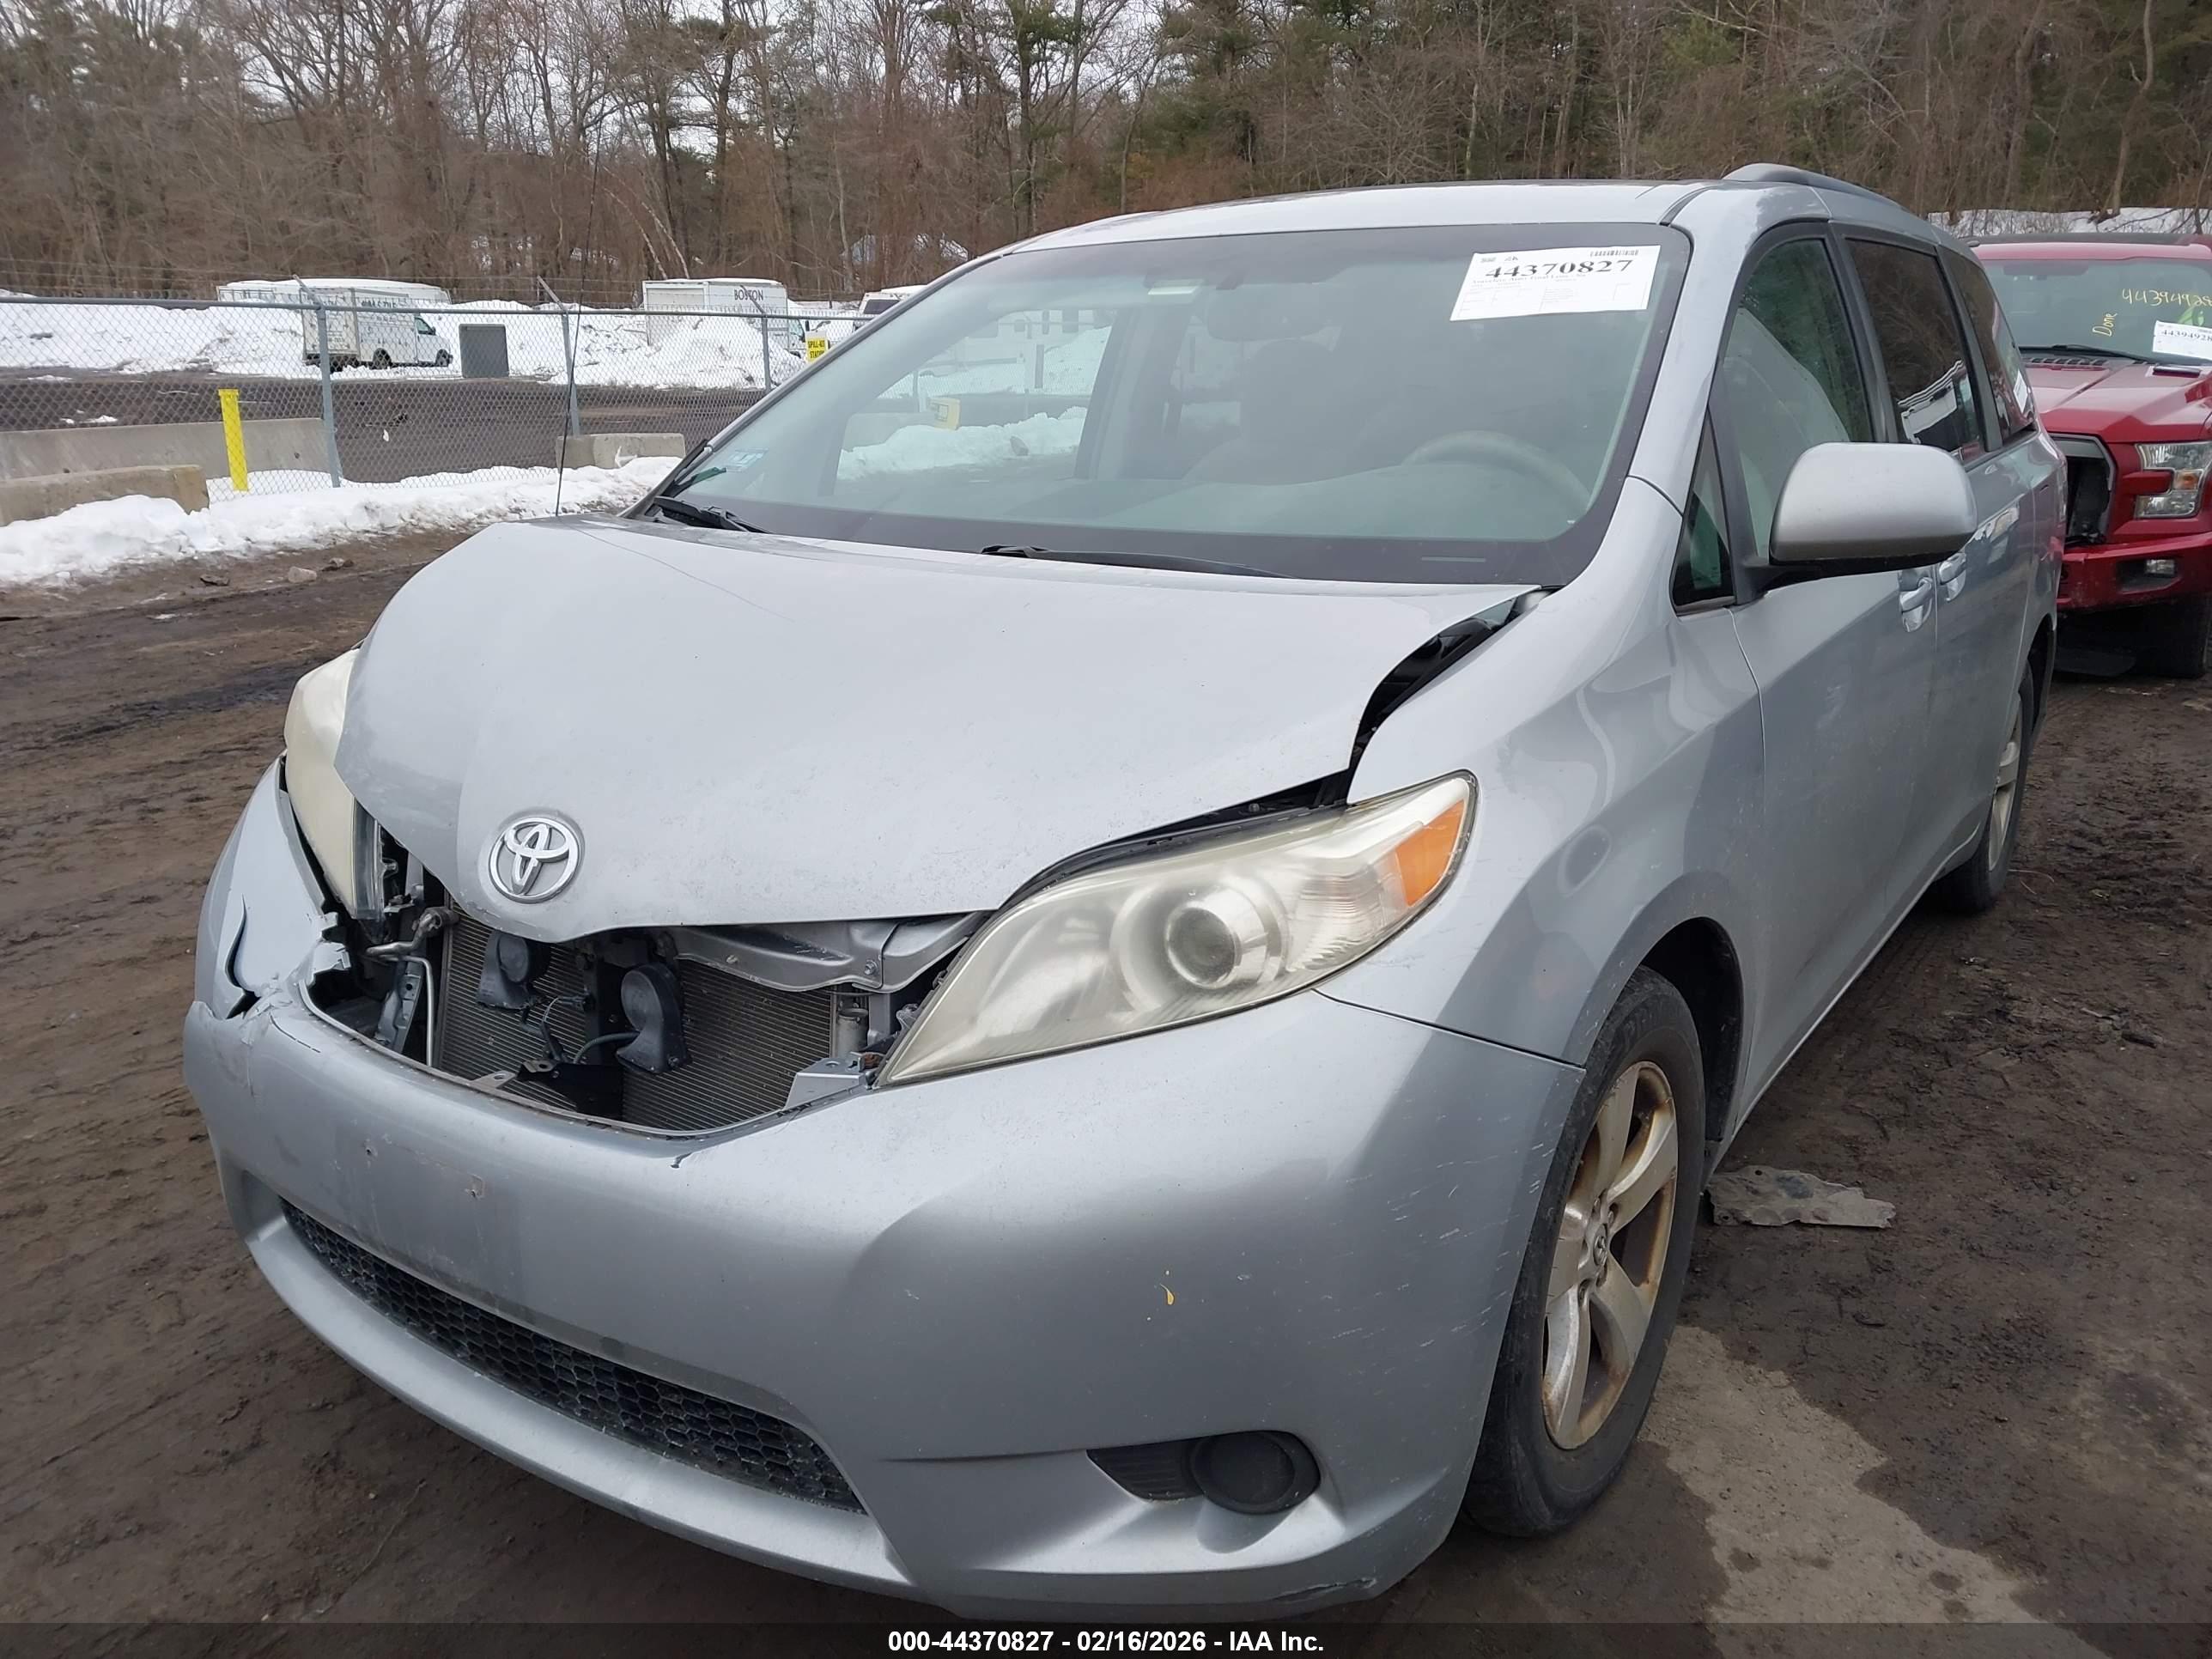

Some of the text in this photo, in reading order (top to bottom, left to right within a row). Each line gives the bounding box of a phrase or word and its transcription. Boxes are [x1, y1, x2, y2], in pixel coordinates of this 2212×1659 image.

[1486, 259, 1632, 278] 44370827
[734, 289, 763, 301] BOSTON
[2092, 312, 2118, 337] Done
